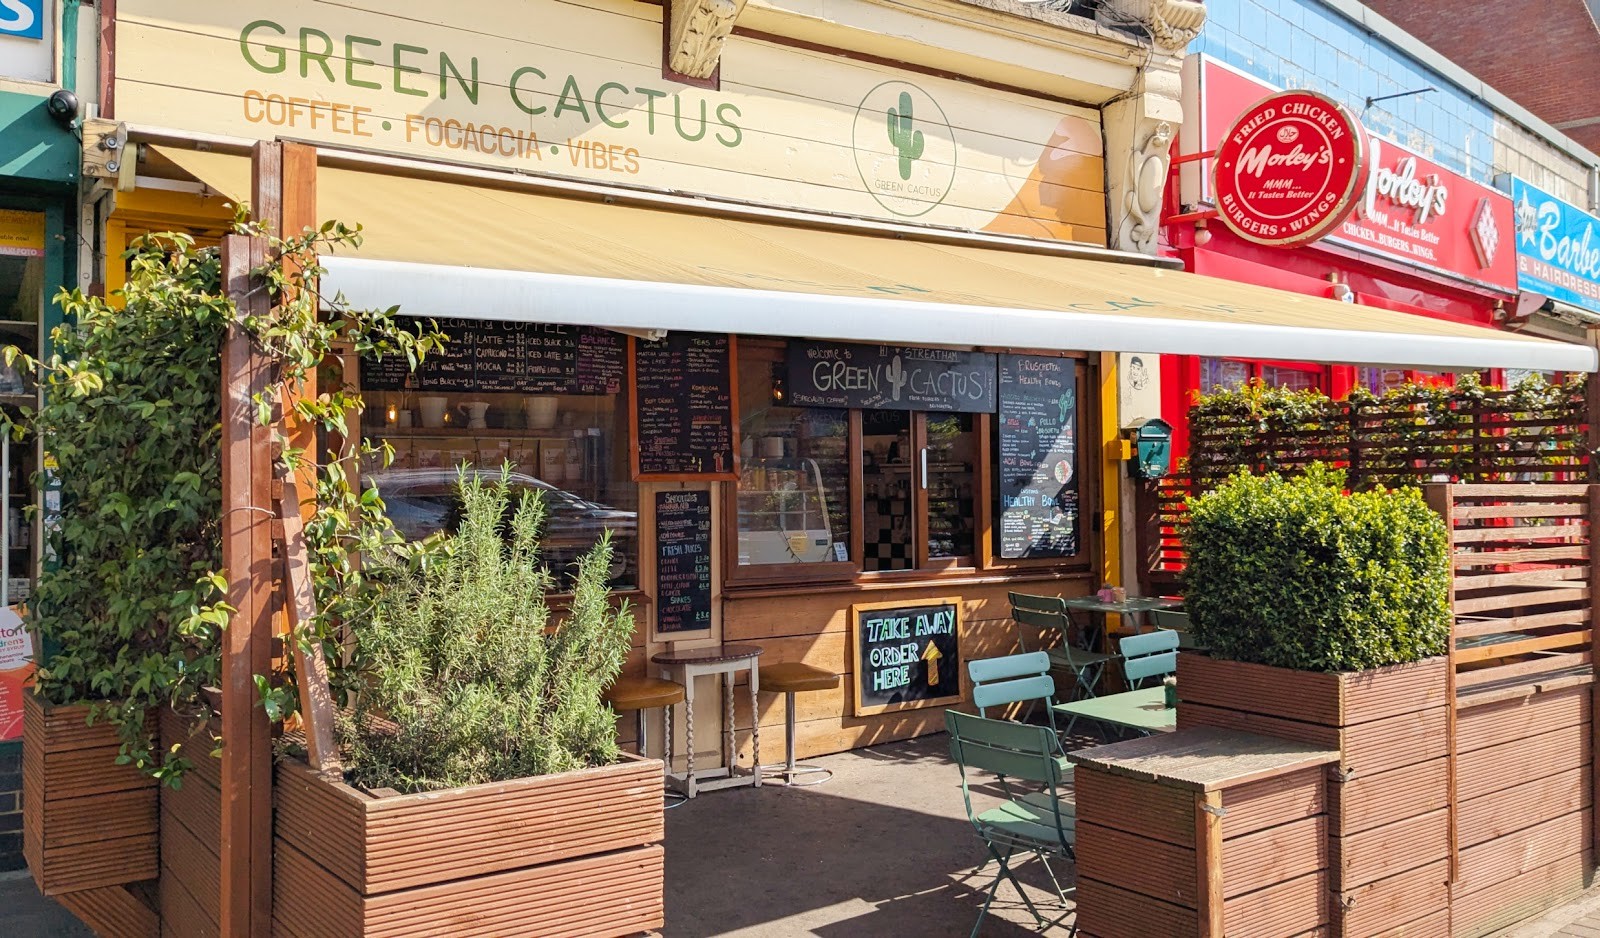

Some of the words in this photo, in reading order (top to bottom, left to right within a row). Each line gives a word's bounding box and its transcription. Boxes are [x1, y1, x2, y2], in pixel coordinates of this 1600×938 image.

[240, 19, 479, 106] GREEN
[508, 66, 744, 148] CACTUS
[243, 89, 373, 138] COFFEE
[405, 114, 542, 161] FOCACCIA
[566, 137, 641, 175] VIBES
[1233, 108, 1276, 145] FRIED
[1282, 103, 1345, 141] CHICKEN
[1236, 143, 1331, 178] Morley's
[874, 179, 904, 192] GREEN
[907, 183, 941, 197] CACTUS
[1247, 191, 1256, 199] It
[1258, 191, 1285, 199] Tastes
[1286, 190, 1314, 199] Better
[1222, 193, 1278, 236] BURGERS
[1289, 191, 1337, 232] WINGS
[476, 335, 504, 345] LATTE
[843, 347, 852, 359] to
[904, 347, 960, 363] STREATHAM
[476, 362, 502, 372] MOCHA
[812, 360, 882, 392] GREEN
[422, 377, 438, 386] LONG
[440, 377, 457, 387] BLACK
[1003, 494, 1036, 507] HEALTHY
[662, 545, 683, 556] FRESH
[670, 596, 692, 604] SHAKES
[867, 616, 911, 643] TAKE
[915, 610, 955, 636] AWAY
[870, 642, 920, 668] ORDER
[873, 665, 911, 691] HERE
